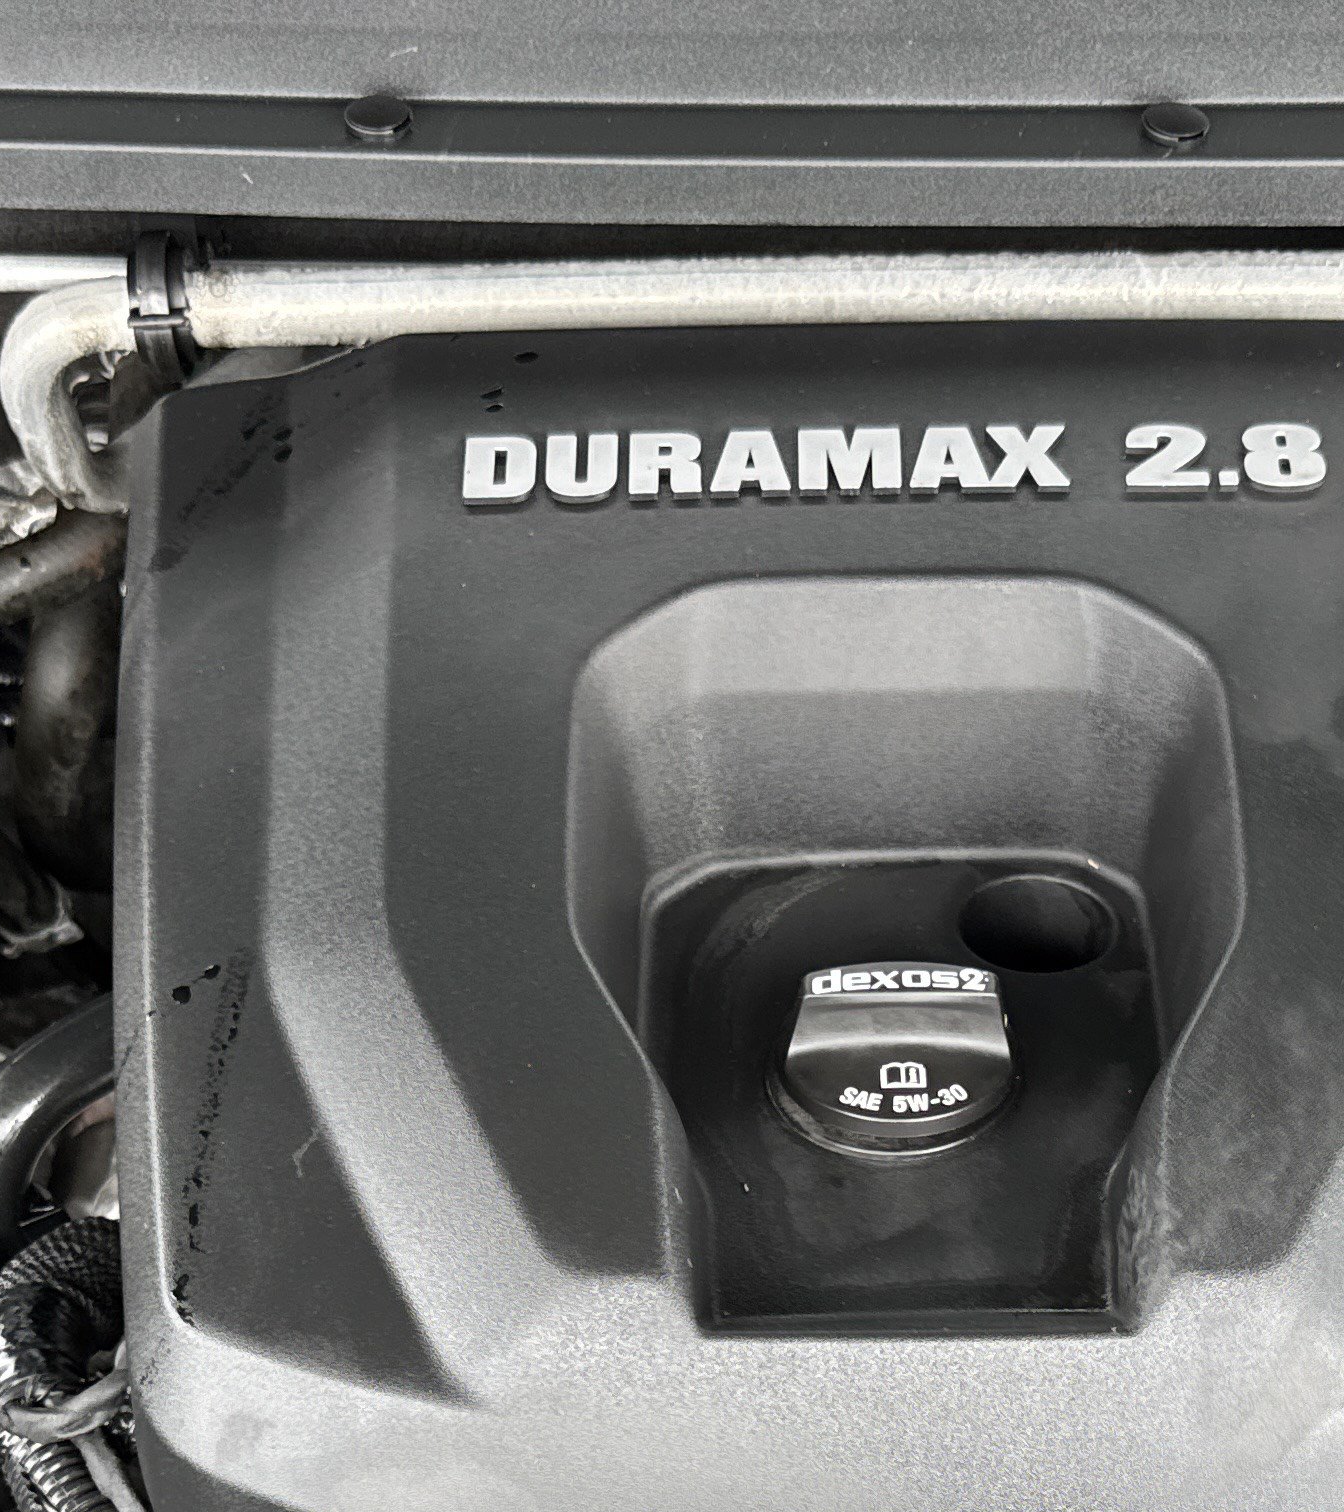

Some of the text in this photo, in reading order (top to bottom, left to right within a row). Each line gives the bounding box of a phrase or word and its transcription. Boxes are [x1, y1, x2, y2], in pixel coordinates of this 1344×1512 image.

[462, 422, 1328, 505] DURAMAX 2.8
[811, 967, 987, 995] dexos2
[839, 1083, 969, 1114] SAE 5W-30
